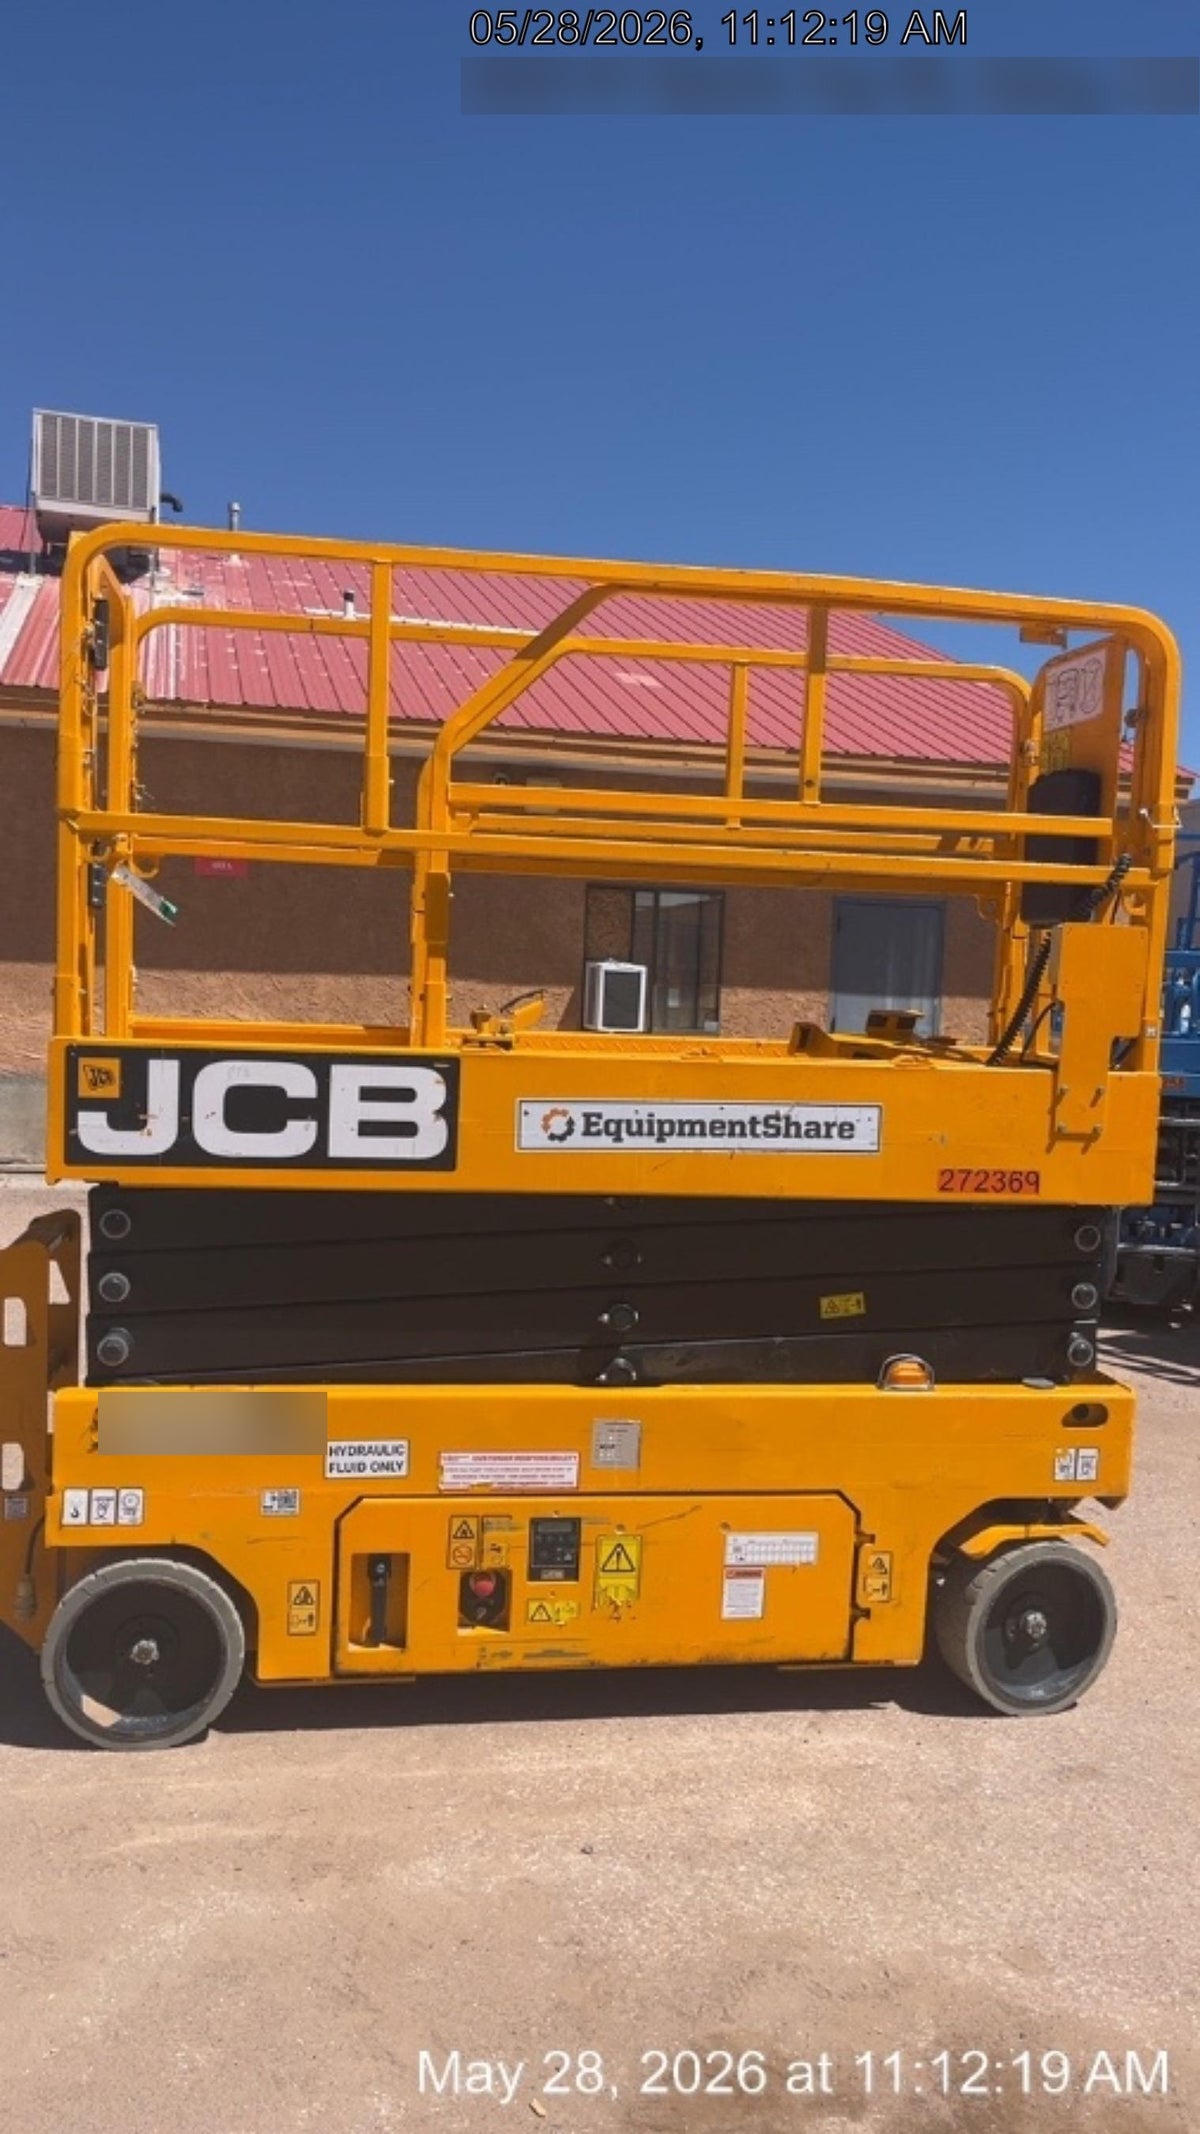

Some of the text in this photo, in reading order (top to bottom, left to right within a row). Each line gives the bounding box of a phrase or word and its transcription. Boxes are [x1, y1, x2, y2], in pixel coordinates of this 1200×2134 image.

[77, 1058, 447, 1160] JCB
[581, 1110, 857, 1143] EquipmentShare
[939, 1168, 1040, 1194] 272369
[329, 1444, 405, 1457] HYDRAULIC
[329, 1460, 404, 1474] FLUID ONLY
